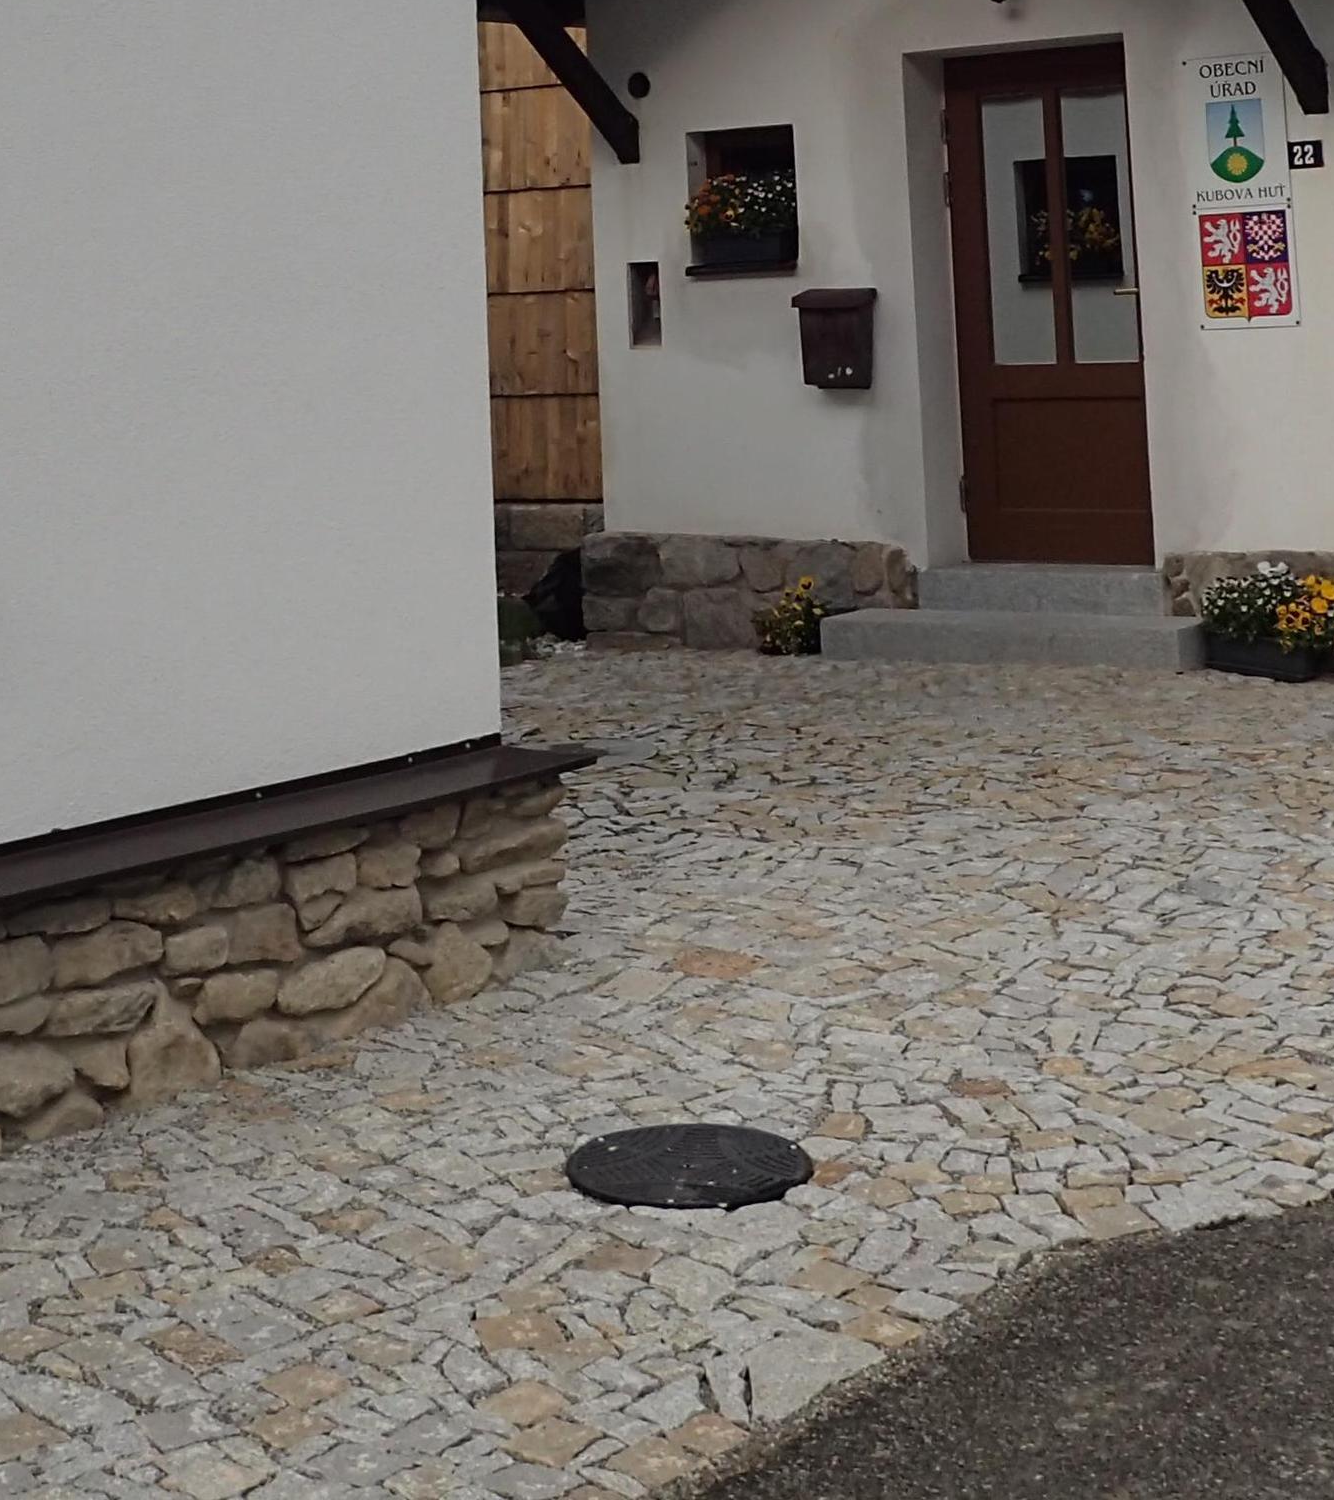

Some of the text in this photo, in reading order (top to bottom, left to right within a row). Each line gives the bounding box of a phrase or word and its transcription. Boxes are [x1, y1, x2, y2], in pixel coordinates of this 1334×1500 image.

[1199, 56, 1264, 78] OBECNÍ
[1210, 80, 1256, 98] ÚŘAD
[1293, 145, 1315, 165] 22
[1196, 188, 1253, 202] KUBOVA
